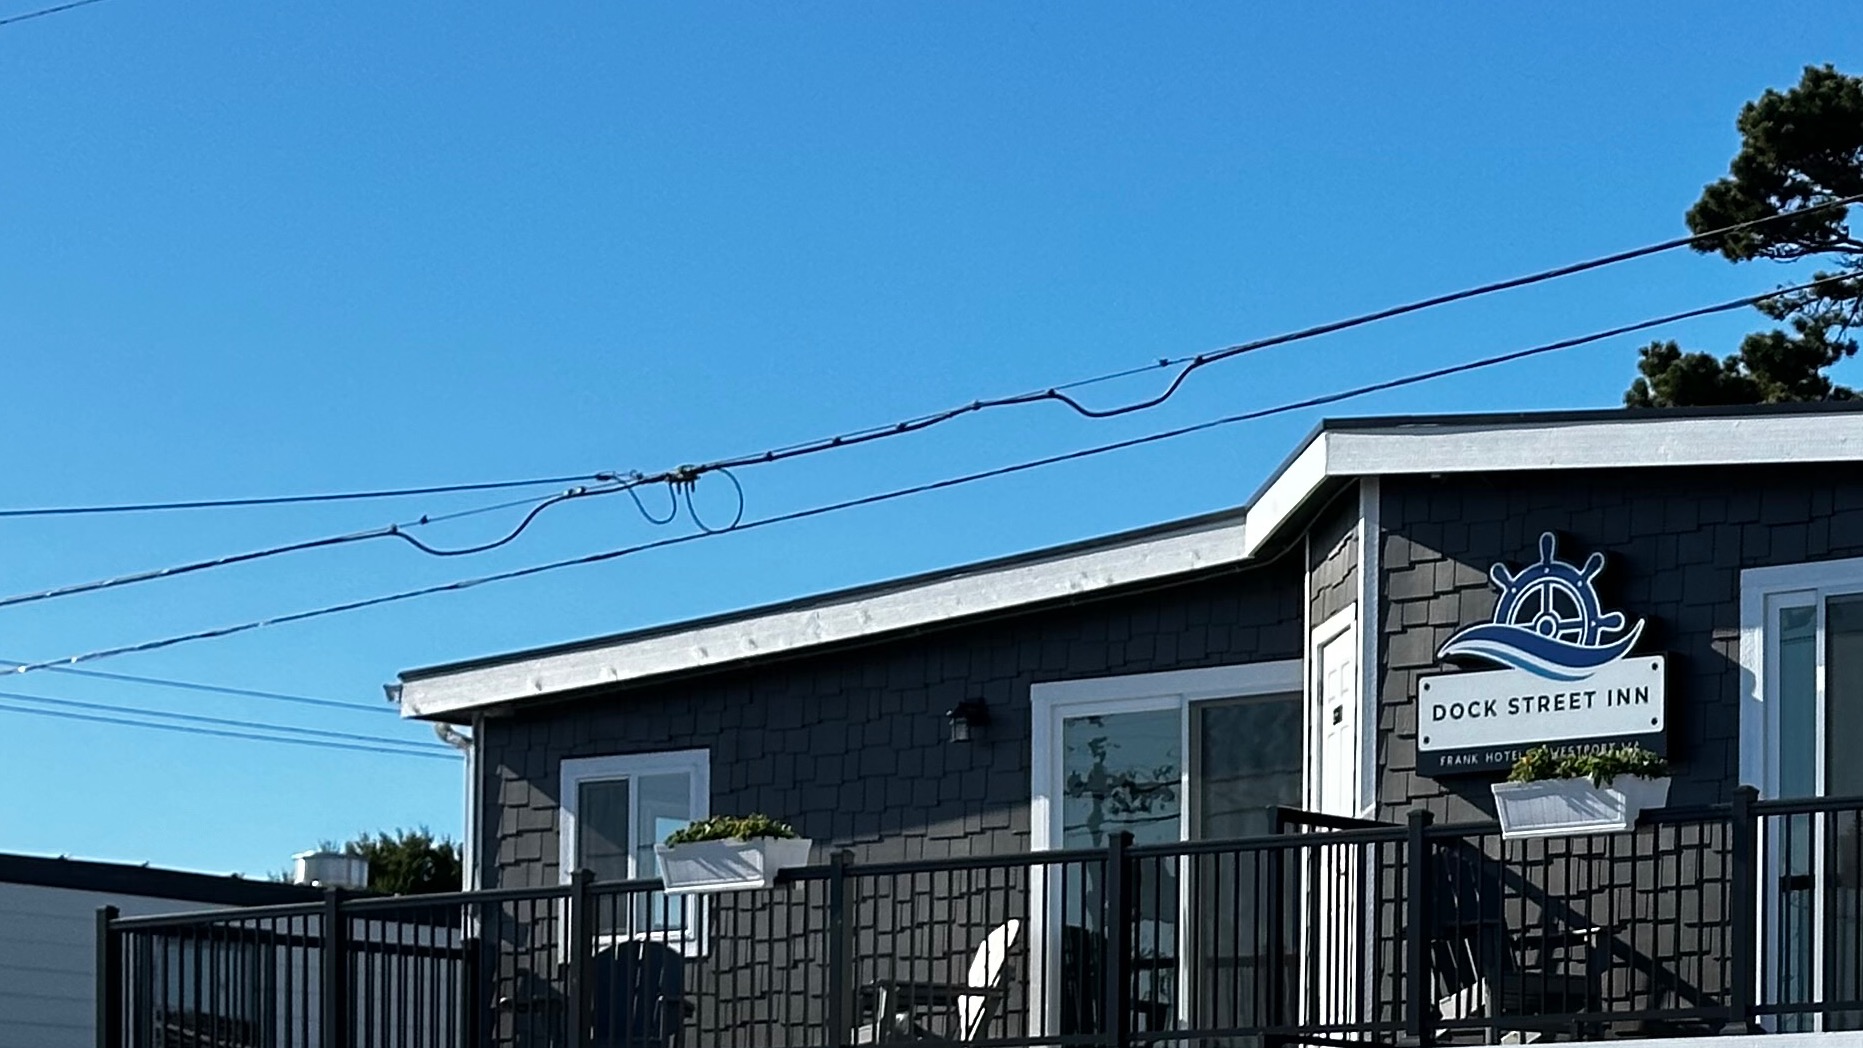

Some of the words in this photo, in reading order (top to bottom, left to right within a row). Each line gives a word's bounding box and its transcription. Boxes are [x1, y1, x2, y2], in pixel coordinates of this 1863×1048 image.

[1432, 699, 1498, 721] DOCK
[1507, 690, 1597, 714] STREET
[1606, 685, 1650, 707] INN
[1439, 754, 1479, 767] FRANK
[1485, 750, 1524, 763] HOTEL
